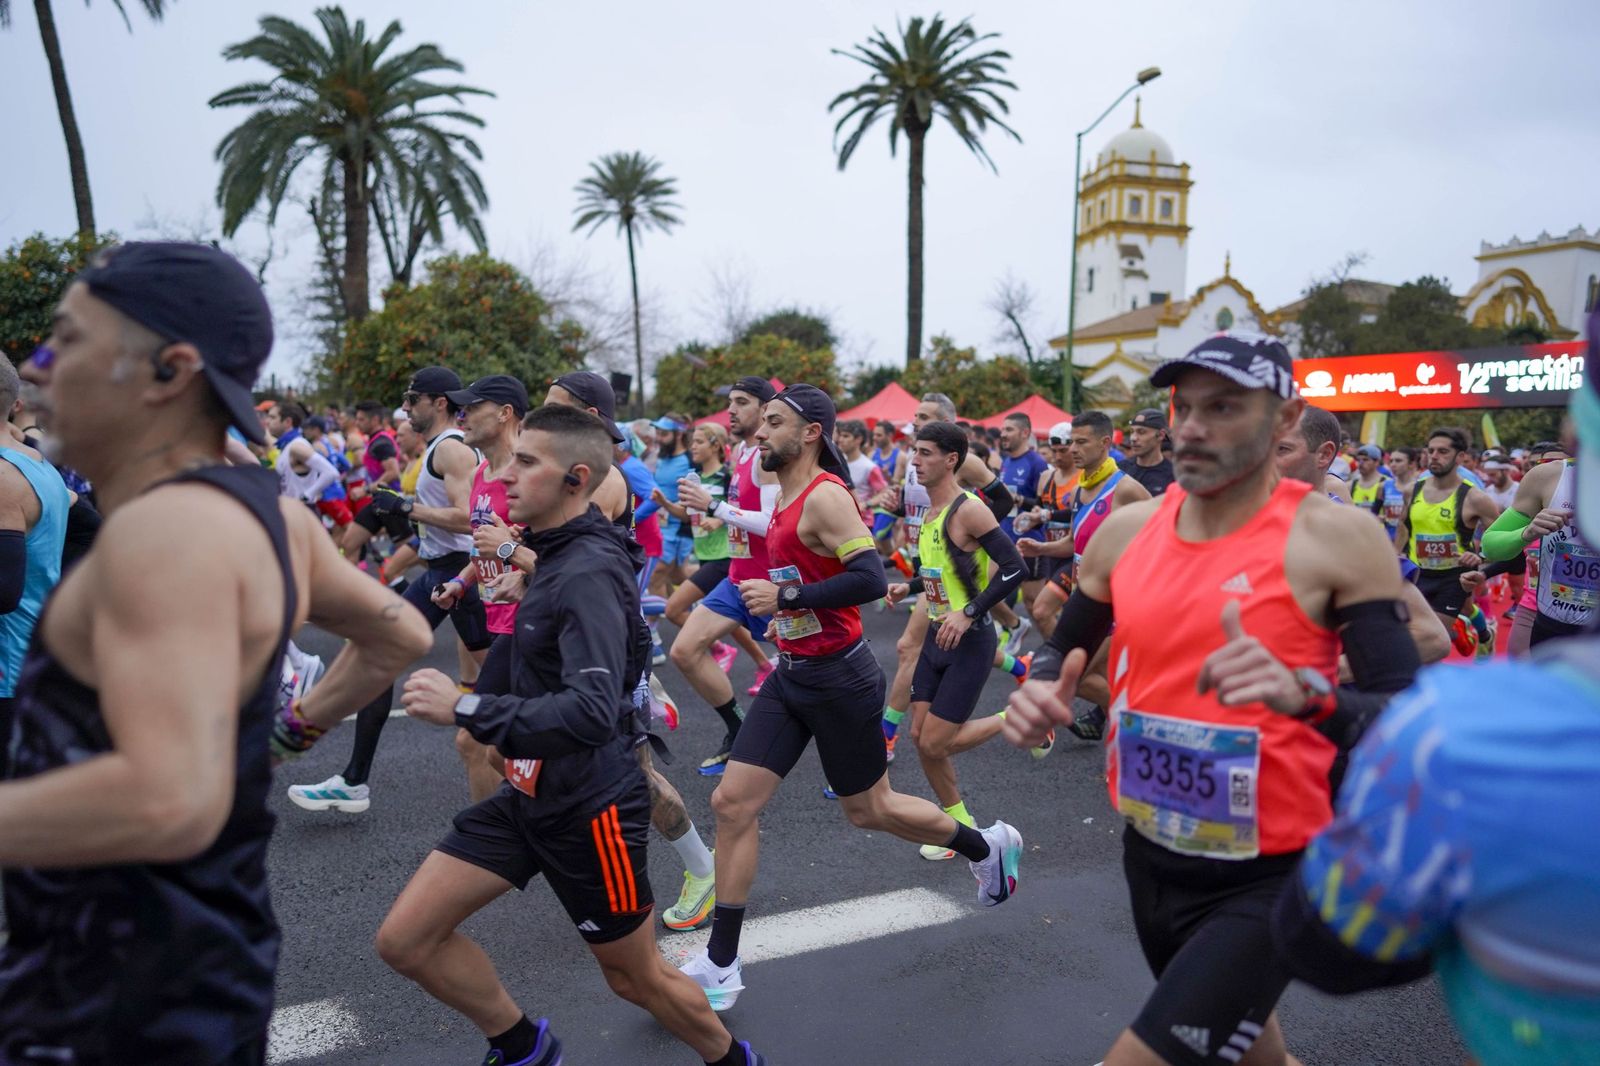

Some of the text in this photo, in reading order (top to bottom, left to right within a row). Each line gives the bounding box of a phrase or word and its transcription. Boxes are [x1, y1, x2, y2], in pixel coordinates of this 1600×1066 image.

[1482, 353, 1584, 378] maratón
[1505, 371, 1583, 392] sevilla
[1424, 543, 1446, 554] 423
[1547, 530, 1567, 554] CLUB
[478, 559, 498, 578] 310
[1562, 558, 1600, 580] 306
[1136, 745, 1216, 799] 3355
